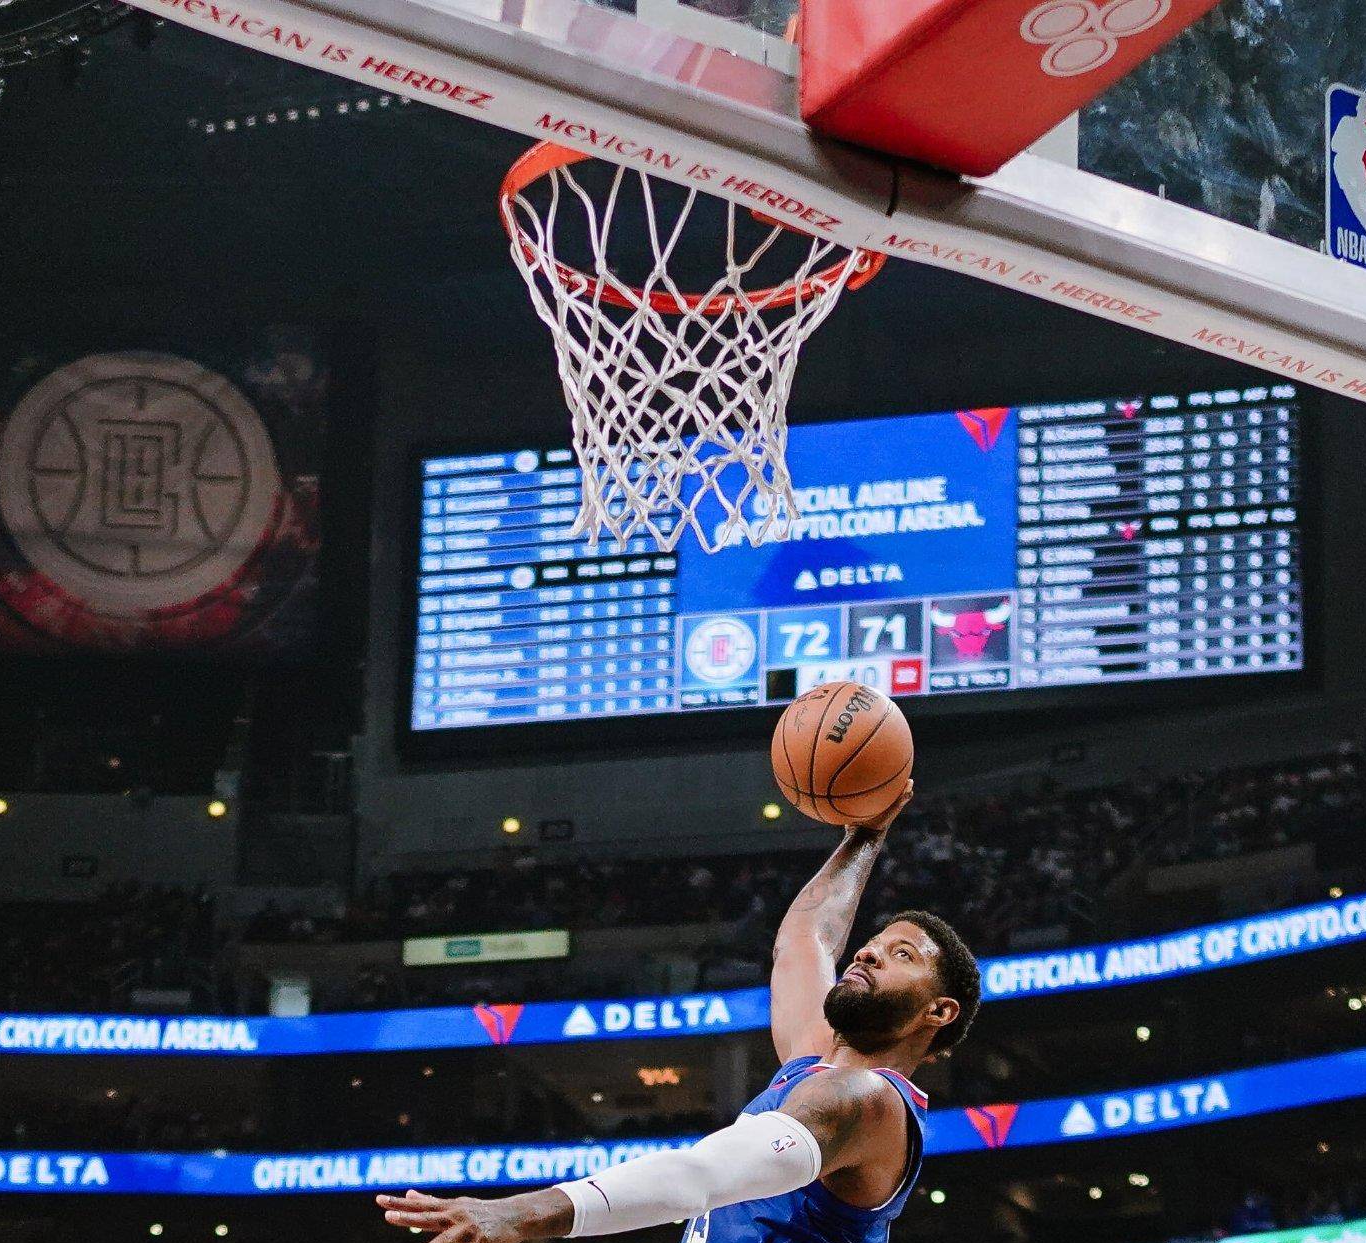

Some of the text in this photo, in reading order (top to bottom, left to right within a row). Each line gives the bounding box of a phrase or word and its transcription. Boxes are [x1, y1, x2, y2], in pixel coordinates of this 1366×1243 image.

[321, 43, 355, 63] IS
[359, 55, 496, 110] HERDEZ
[534, 112, 842, 233] MEXICAN IS HERDEZ
[1018, 268, 1049, 286] IS
[1050, 280, 1162, 327] HERDEZ
[1315, 368, 1344, 385] IS
[857, 475, 947, 509] AIRLINE
[820, 562, 903, 588] DELTA
[779, 613, 907, 658] 72 71
[986, 951, 1101, 994] OFFICIAL
[1103, 934, 1202, 981] AIRLINE
[1203, 926, 1238, 963] OF
[162, 1019, 258, 1051] ARENA.
[603, 998, 730, 1033] DELTA
[1103, 1081, 1230, 1130] DELTA
[253, 1156, 362, 1189] OFFICIAL
[366, 1151, 465, 1185] AIRLINE
[467, 1150, 503, 1181] OF
